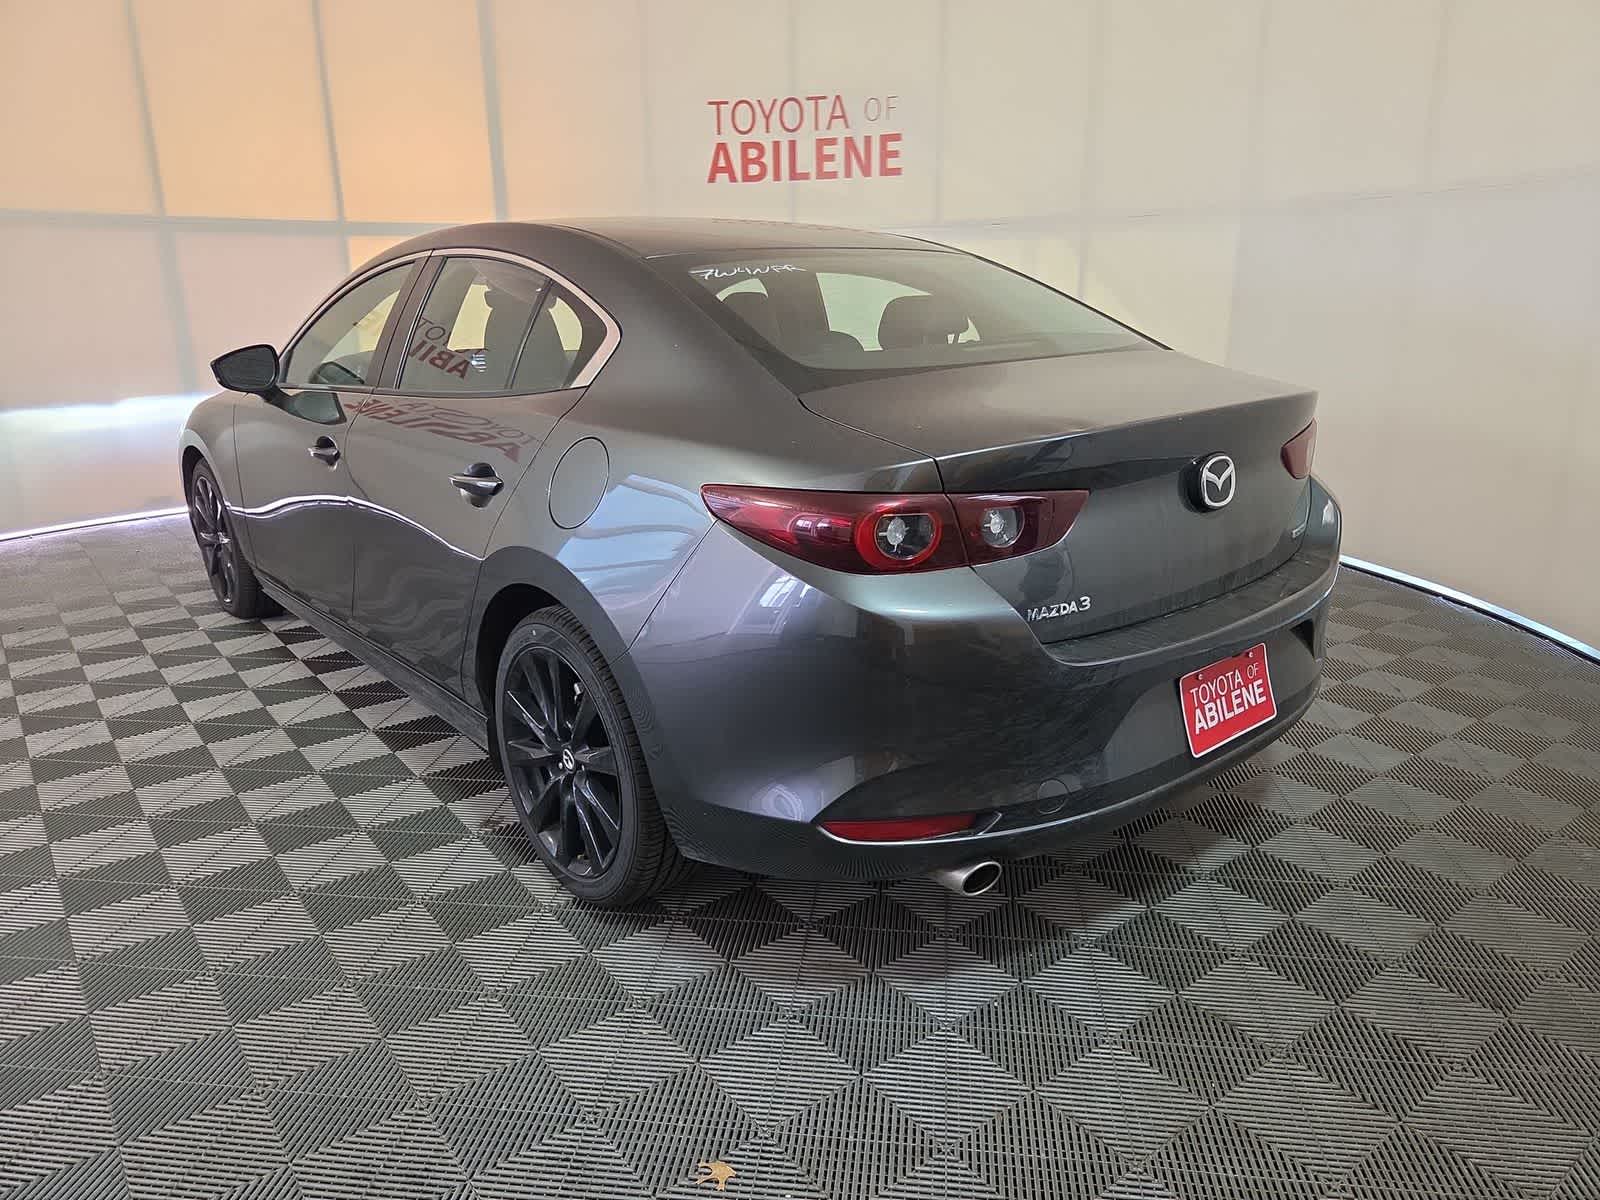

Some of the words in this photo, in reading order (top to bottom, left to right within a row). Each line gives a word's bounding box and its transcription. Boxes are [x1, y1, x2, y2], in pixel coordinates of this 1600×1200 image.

[707, 94, 849, 135] TOYOTA
[863, 95, 899, 121] OF
[707, 133, 903, 183] ABILENE
[1190, 669, 1244, 707] TOYOTA
[1247, 662, 1259, 679] OF
[1195, 679, 1266, 735] ABILENE
